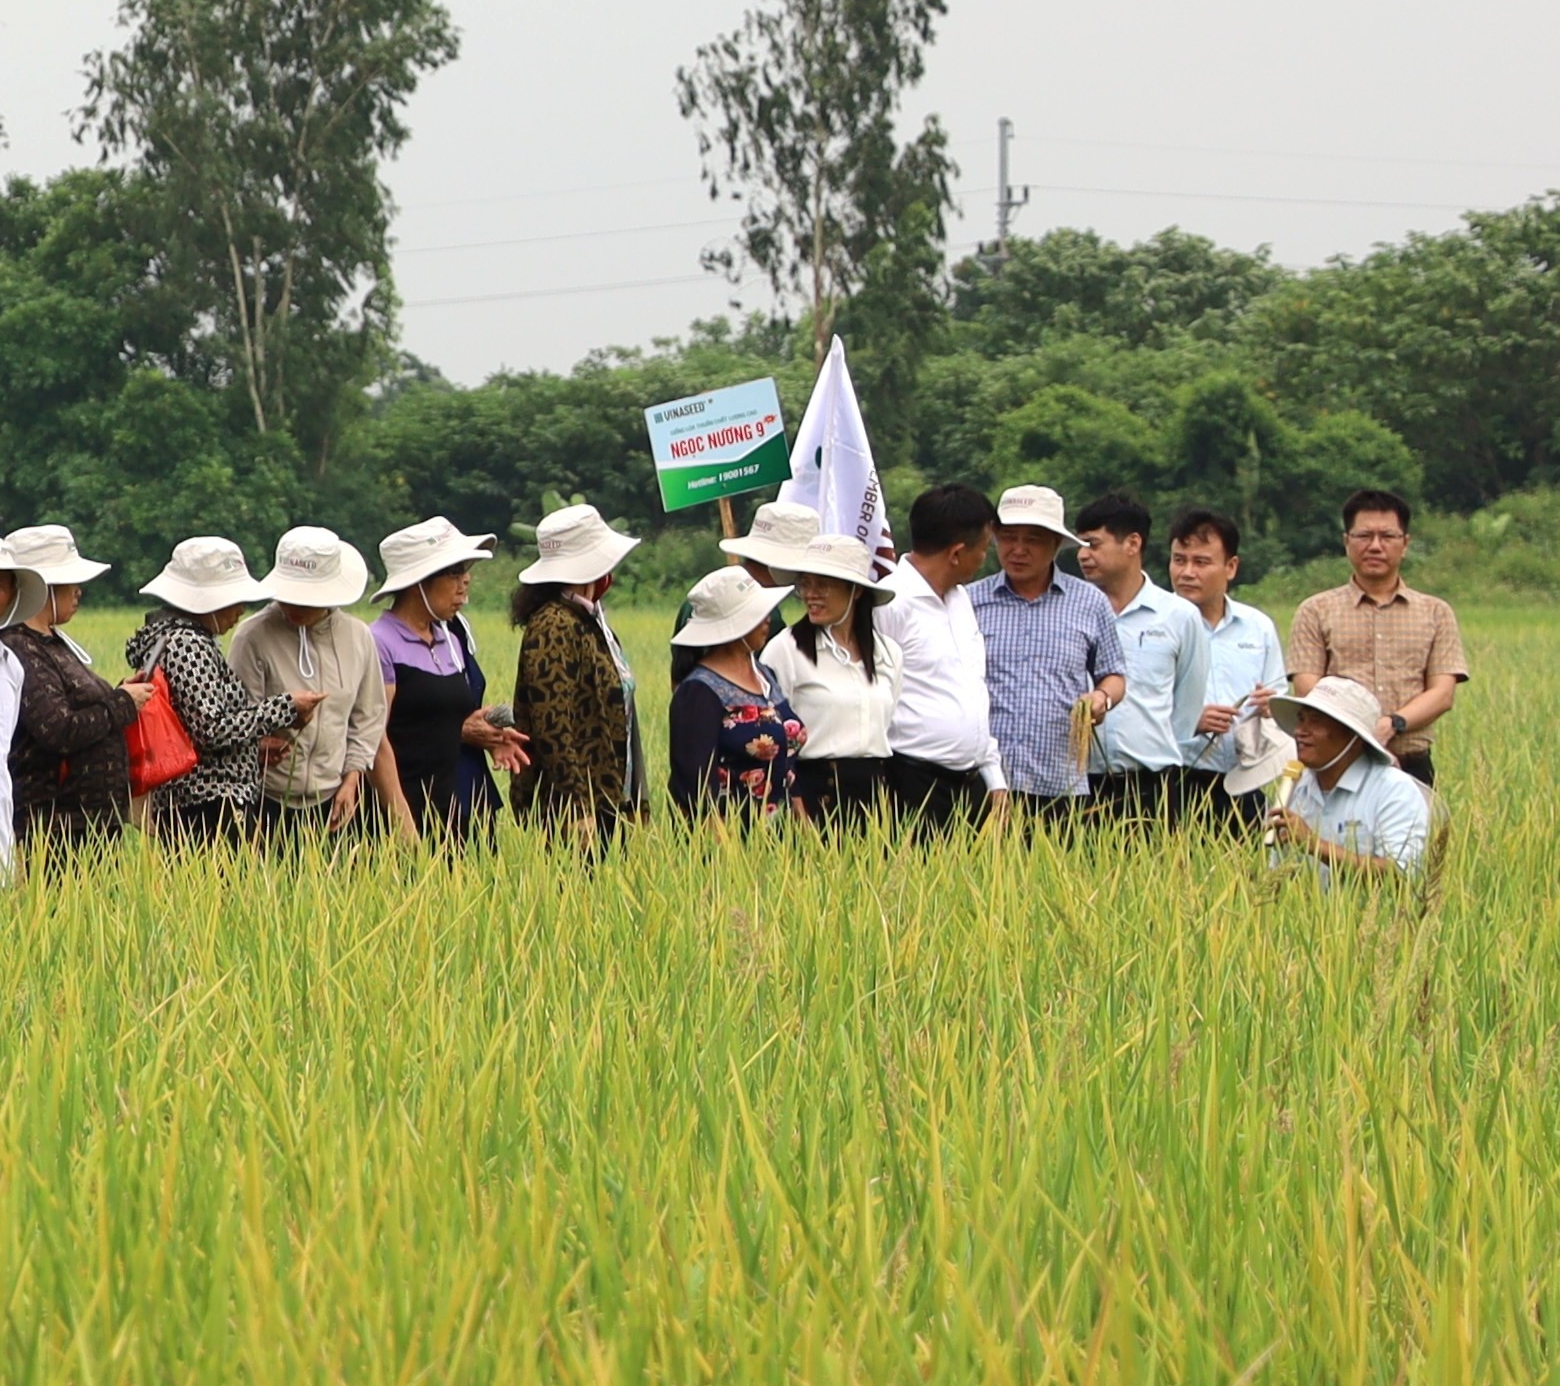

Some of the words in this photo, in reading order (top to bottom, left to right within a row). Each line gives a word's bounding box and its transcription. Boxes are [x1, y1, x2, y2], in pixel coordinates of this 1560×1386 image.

[670, 436, 705, 459] NGỌC
[707, 424, 753, 450] NƯƠNG
[755, 421, 765, 438] 9
